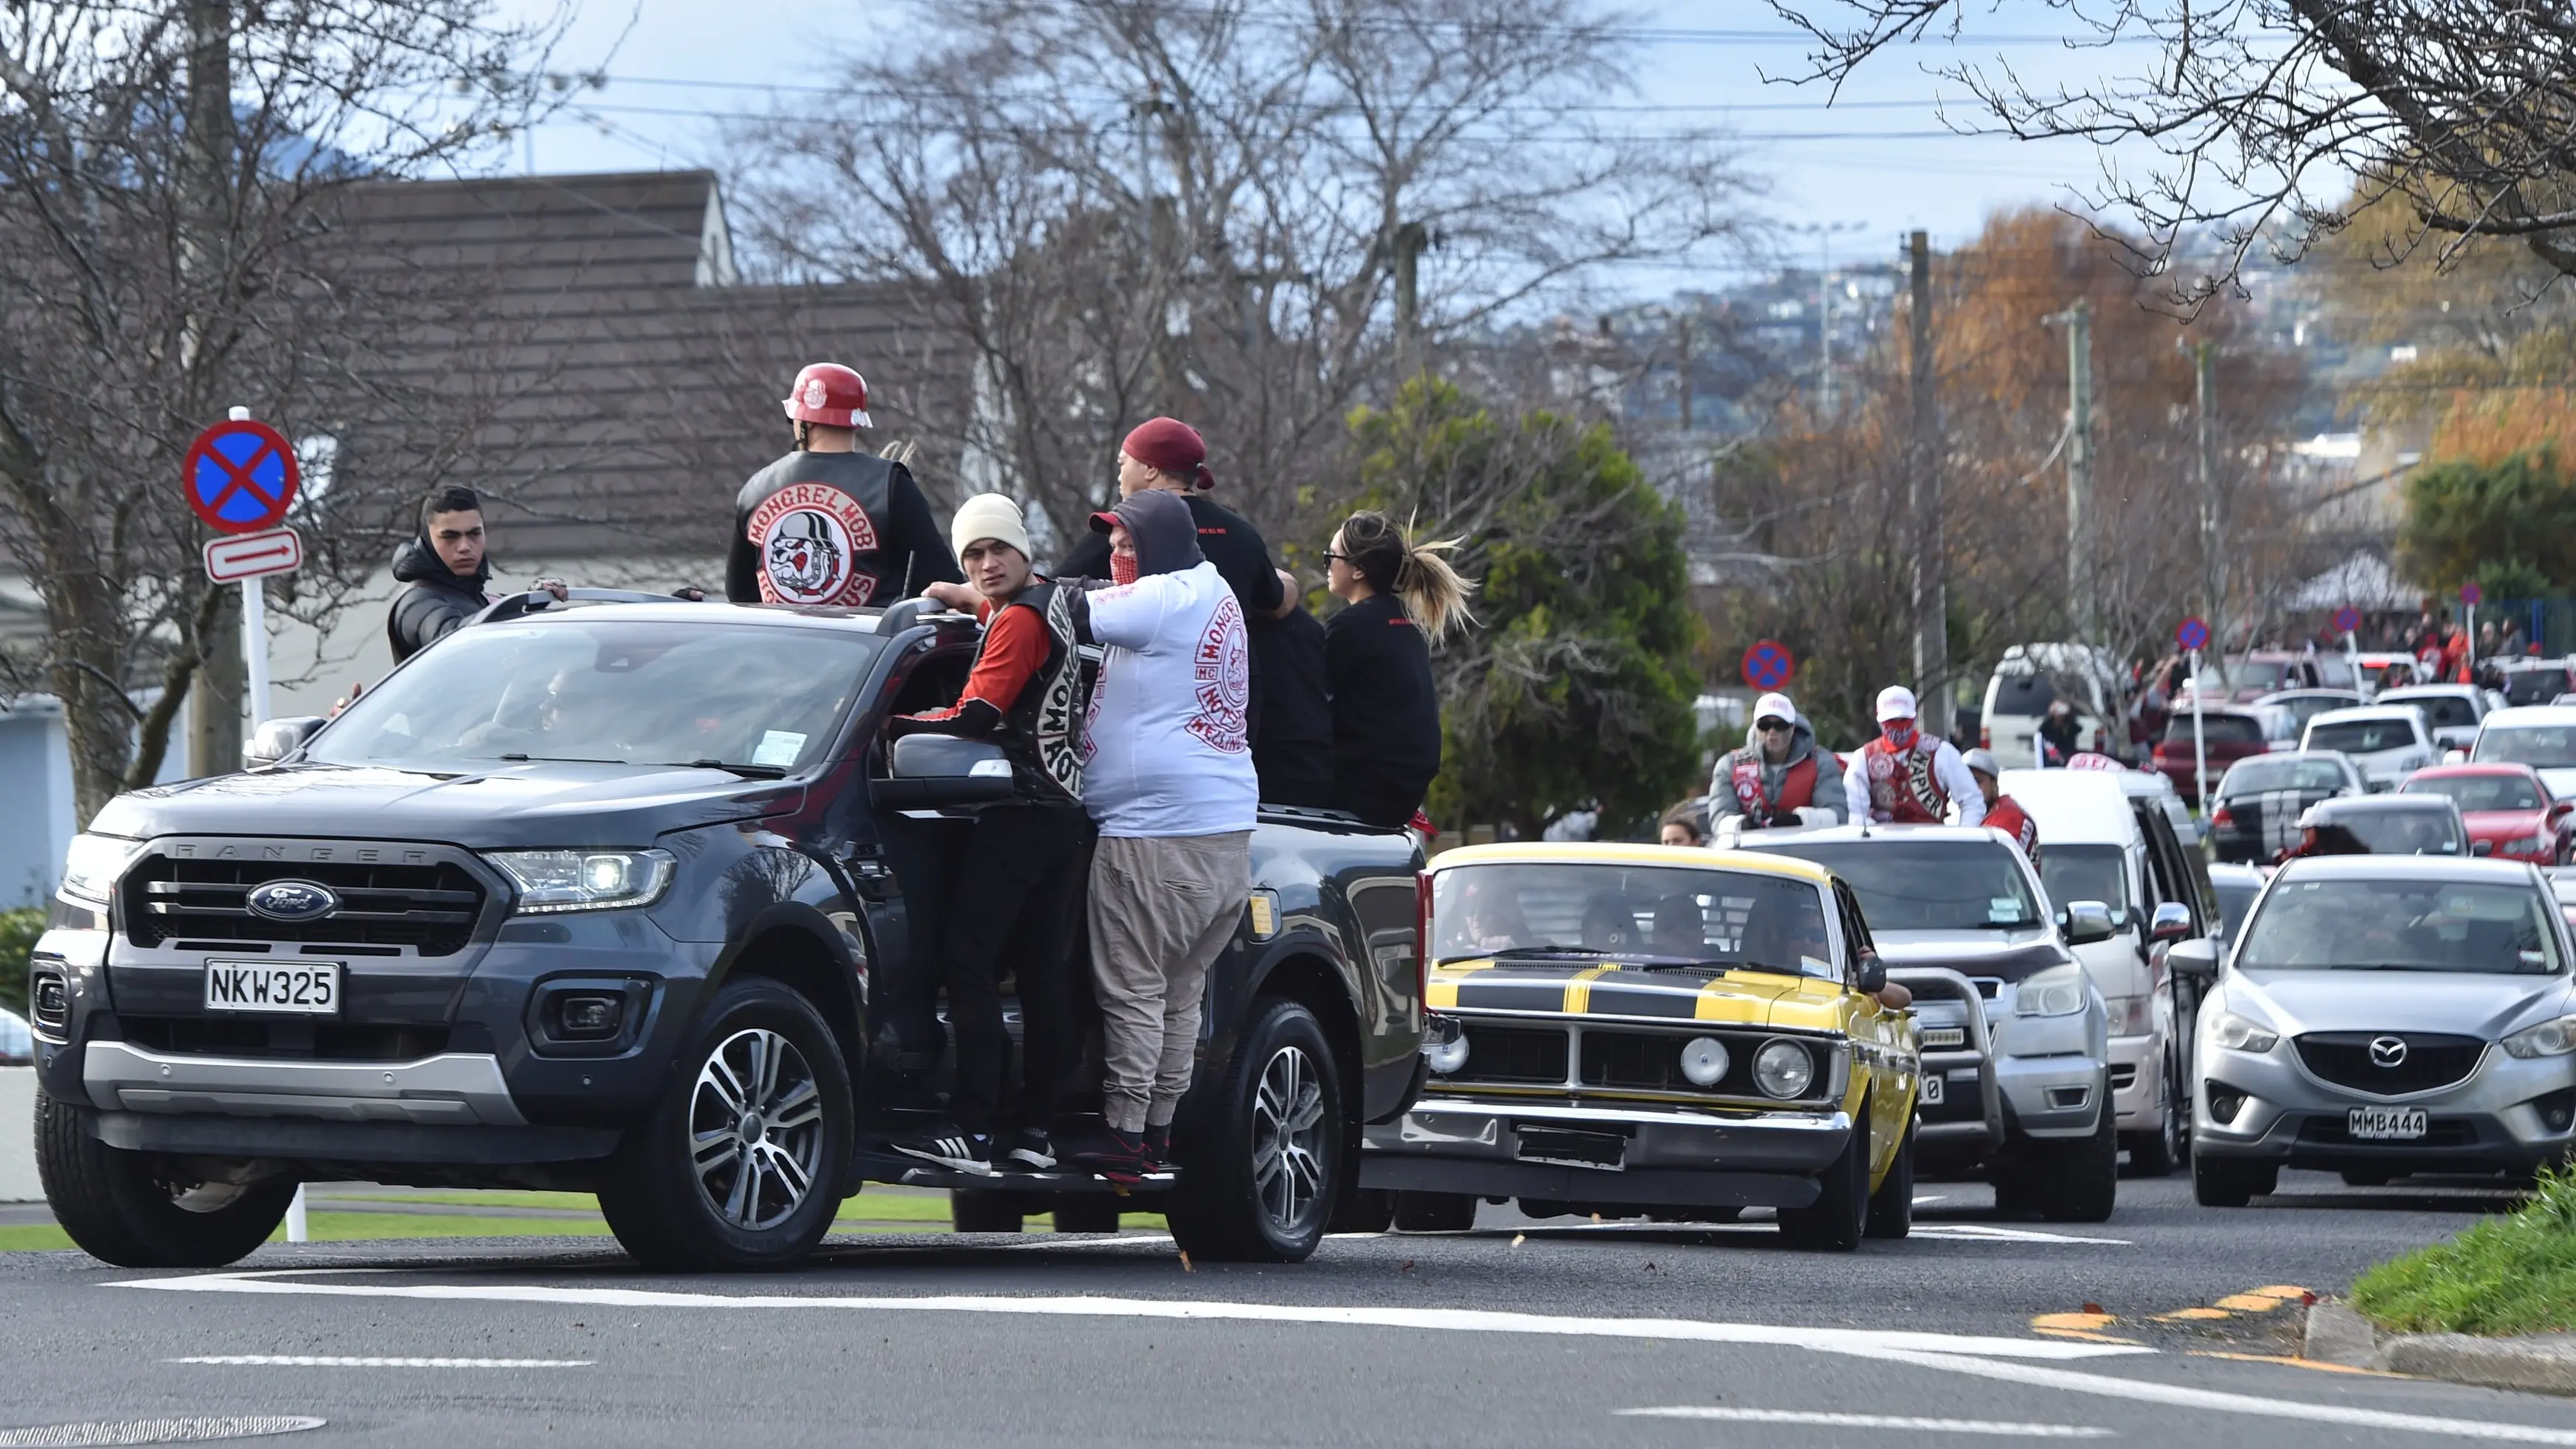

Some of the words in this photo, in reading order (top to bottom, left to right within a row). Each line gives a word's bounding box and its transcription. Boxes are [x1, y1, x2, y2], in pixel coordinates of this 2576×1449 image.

[750, 484, 839, 541] MONGREL
[840, 503, 874, 548] MOB
[1202, 600, 1239, 660] MONGR
[1198, 668, 1215, 679] MC
[1911, 750, 1943, 818] NAPIER
[176, 843, 427, 863] RANGER
[266, 888, 312, 909] Ford
[211, 968, 332, 1005] NKW325
[2351, 1112, 2425, 1134] MMB444
